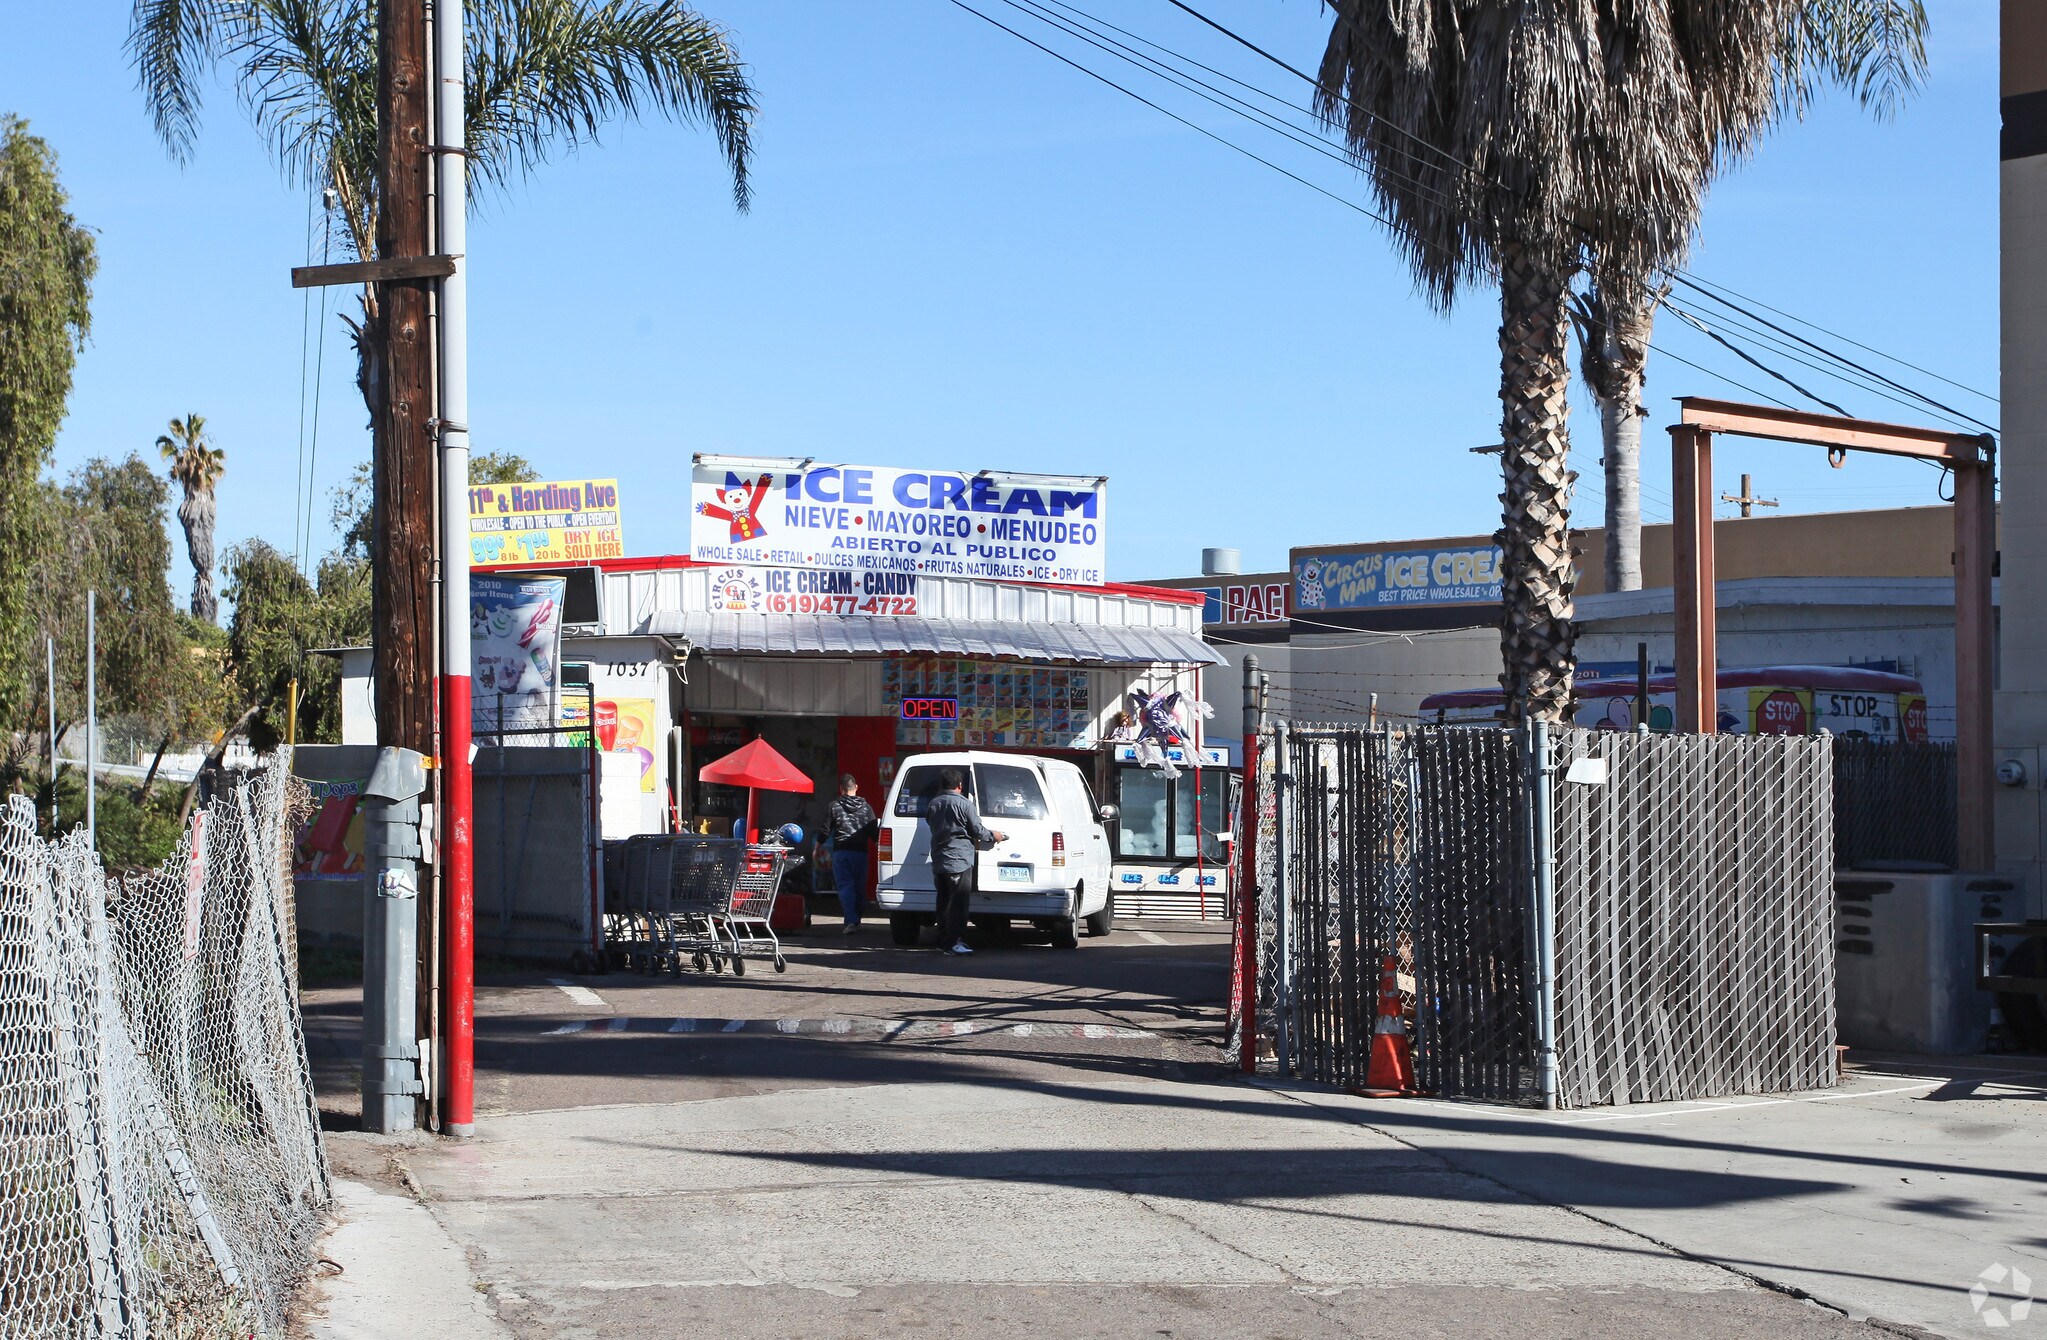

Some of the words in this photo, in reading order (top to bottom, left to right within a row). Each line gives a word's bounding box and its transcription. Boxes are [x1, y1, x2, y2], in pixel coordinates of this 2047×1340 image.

[498, 494, 509, 513] &
[511, 484, 582, 513] Harding
[585, 482, 616, 508] Ave
[785, 467, 873, 504] ICE
[892, 473, 1098, 519] CREAM
[471, 517, 505, 532] WHOLESALE
[510, 516, 526, 530] OPEN
[526, 516, 534, 529] TO
[535, 515, 546, 529] THE
[546, 514, 567, 529] PUBLIC
[572, 513, 588, 527] OPEN
[588, 511, 616, 527] EVERYDAY
[785, 505, 849, 530] NIEVE
[867, 510, 971, 538] MAYOREO
[991, 518, 1097, 545] MENUDEO
[564, 530, 591, 544] DRY
[597, 528, 620, 542] ICE
[501, 553, 507, 561] 8
[536, 551, 549, 559] 20
[550, 550, 560, 559] lb
[565, 544, 592, 559] SOLD
[595, 543, 621, 557] HERE
[831, 535, 922, 554] ABIERTO
[931, 542, 957, 556] AL
[966, 544, 1056, 561] PUBLICO
[698, 546, 733, 560] WHOLE
[736, 547, 762, 562] SALE
[771, 550, 805, 564] RETAIL
[815, 552, 854, 567] DULCES
[857, 555, 916, 571] MEXICANOS
[925, 559, 963, 574] FRUTAS
[966, 562, 1025, 578] NATURALES
[1034, 566, 1050, 579] ICE
[1059, 567, 1079, 581] DRY
[1082, 569, 1098, 582] ICE
[1324, 553, 1383, 589] CIRCUS
[1384, 554, 1430, 588] ICE
[478, 580, 502, 589] 2010
[712, 569, 744, 610] CIRCUS
[748, 577, 762, 611] MAN
[766, 570, 791, 593] ICE
[797, 570, 852, 594] CREAM
[863, 571, 916, 595] CANDY
[1339, 575, 1376, 605] MAN
[490, 590, 514, 599] Items
[1378, 589, 1398, 602] BEST
[1401, 588, 1427, 601] PRICE!
[1430, 586, 1480, 600] WHOLESALE
[1488, 585, 1503, 598] OP
[766, 595, 917, 615] (619)477-4722
[606, 661, 649, 677] 1037
[1576, 670, 1600, 680] 2011
[903, 699, 956, 718] OPEN
[1765, 700, 1800, 722] STOP
[1830, 694, 1877, 718] STOP
[1120, 873, 1144, 885] ICE
[1157, 873, 1180, 885] ICE
[1194, 874, 1218, 886] ICE
